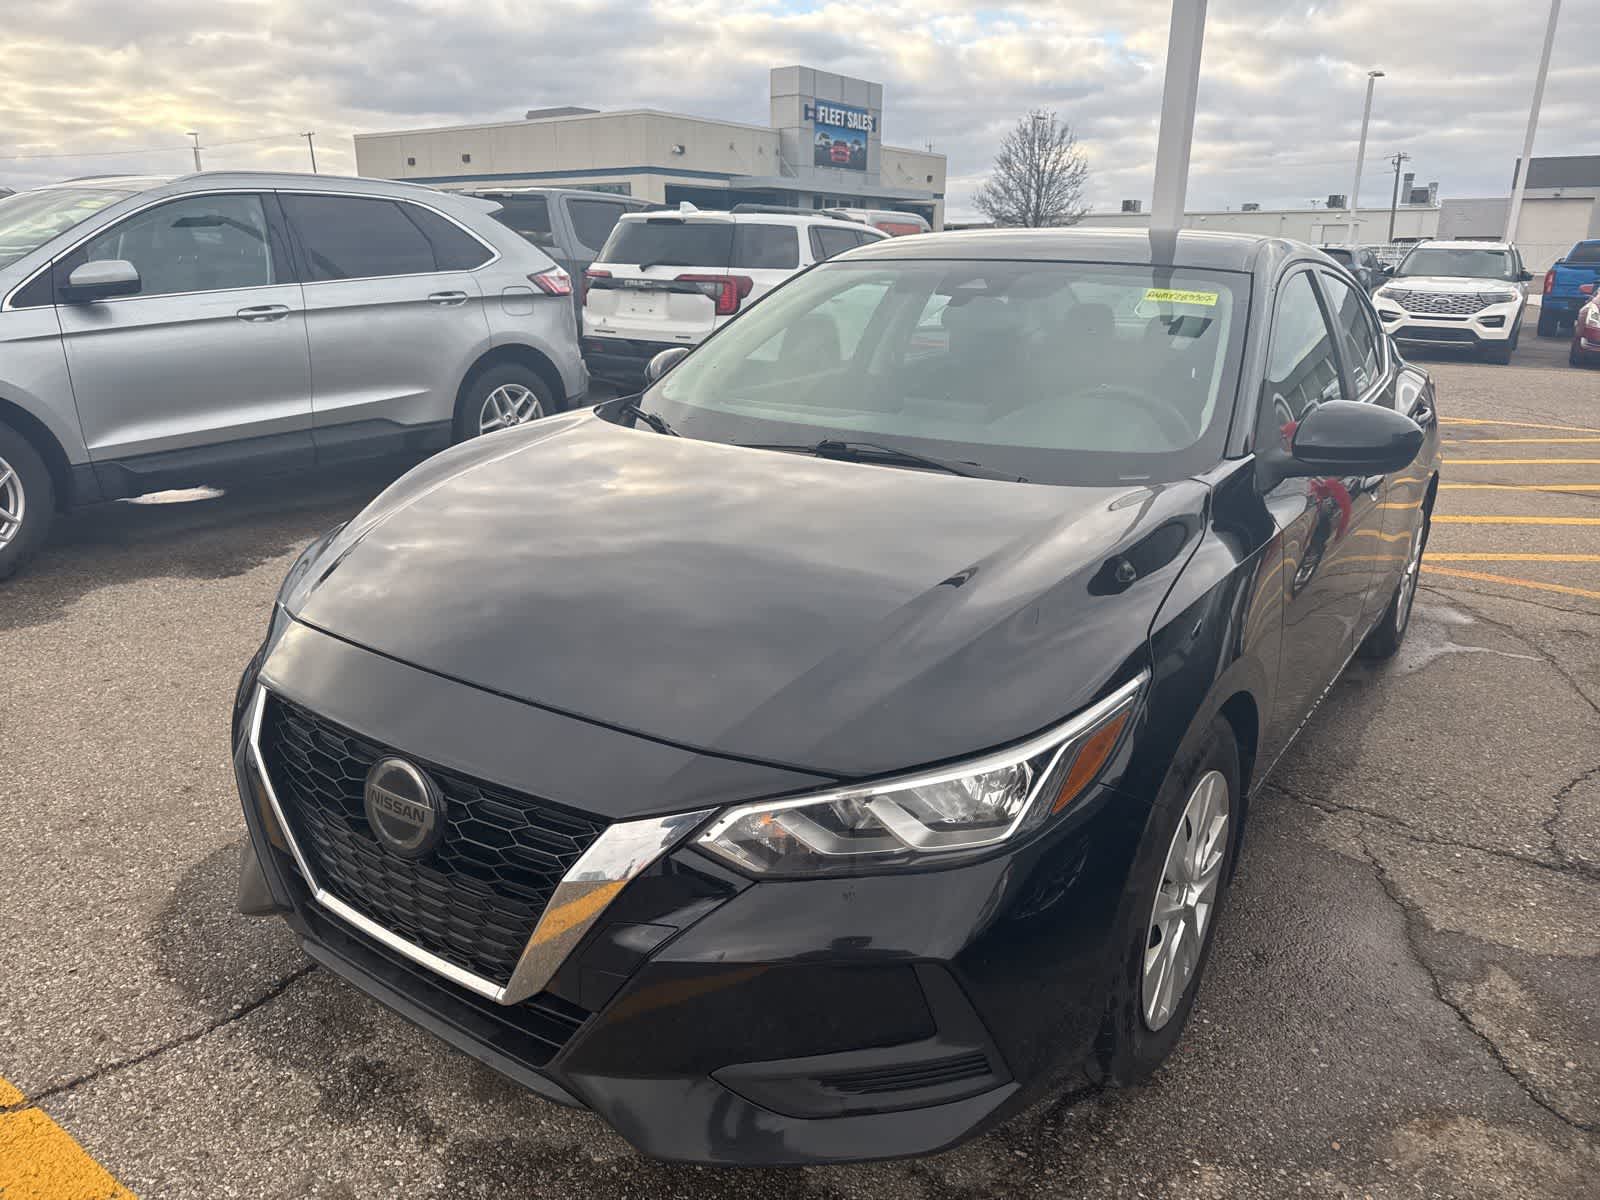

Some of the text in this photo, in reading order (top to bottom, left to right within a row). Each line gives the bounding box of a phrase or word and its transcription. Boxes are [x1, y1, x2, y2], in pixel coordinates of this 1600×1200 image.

[818, 105, 873, 132] FLEET SALES
[371, 789, 425, 822] NISSAN
